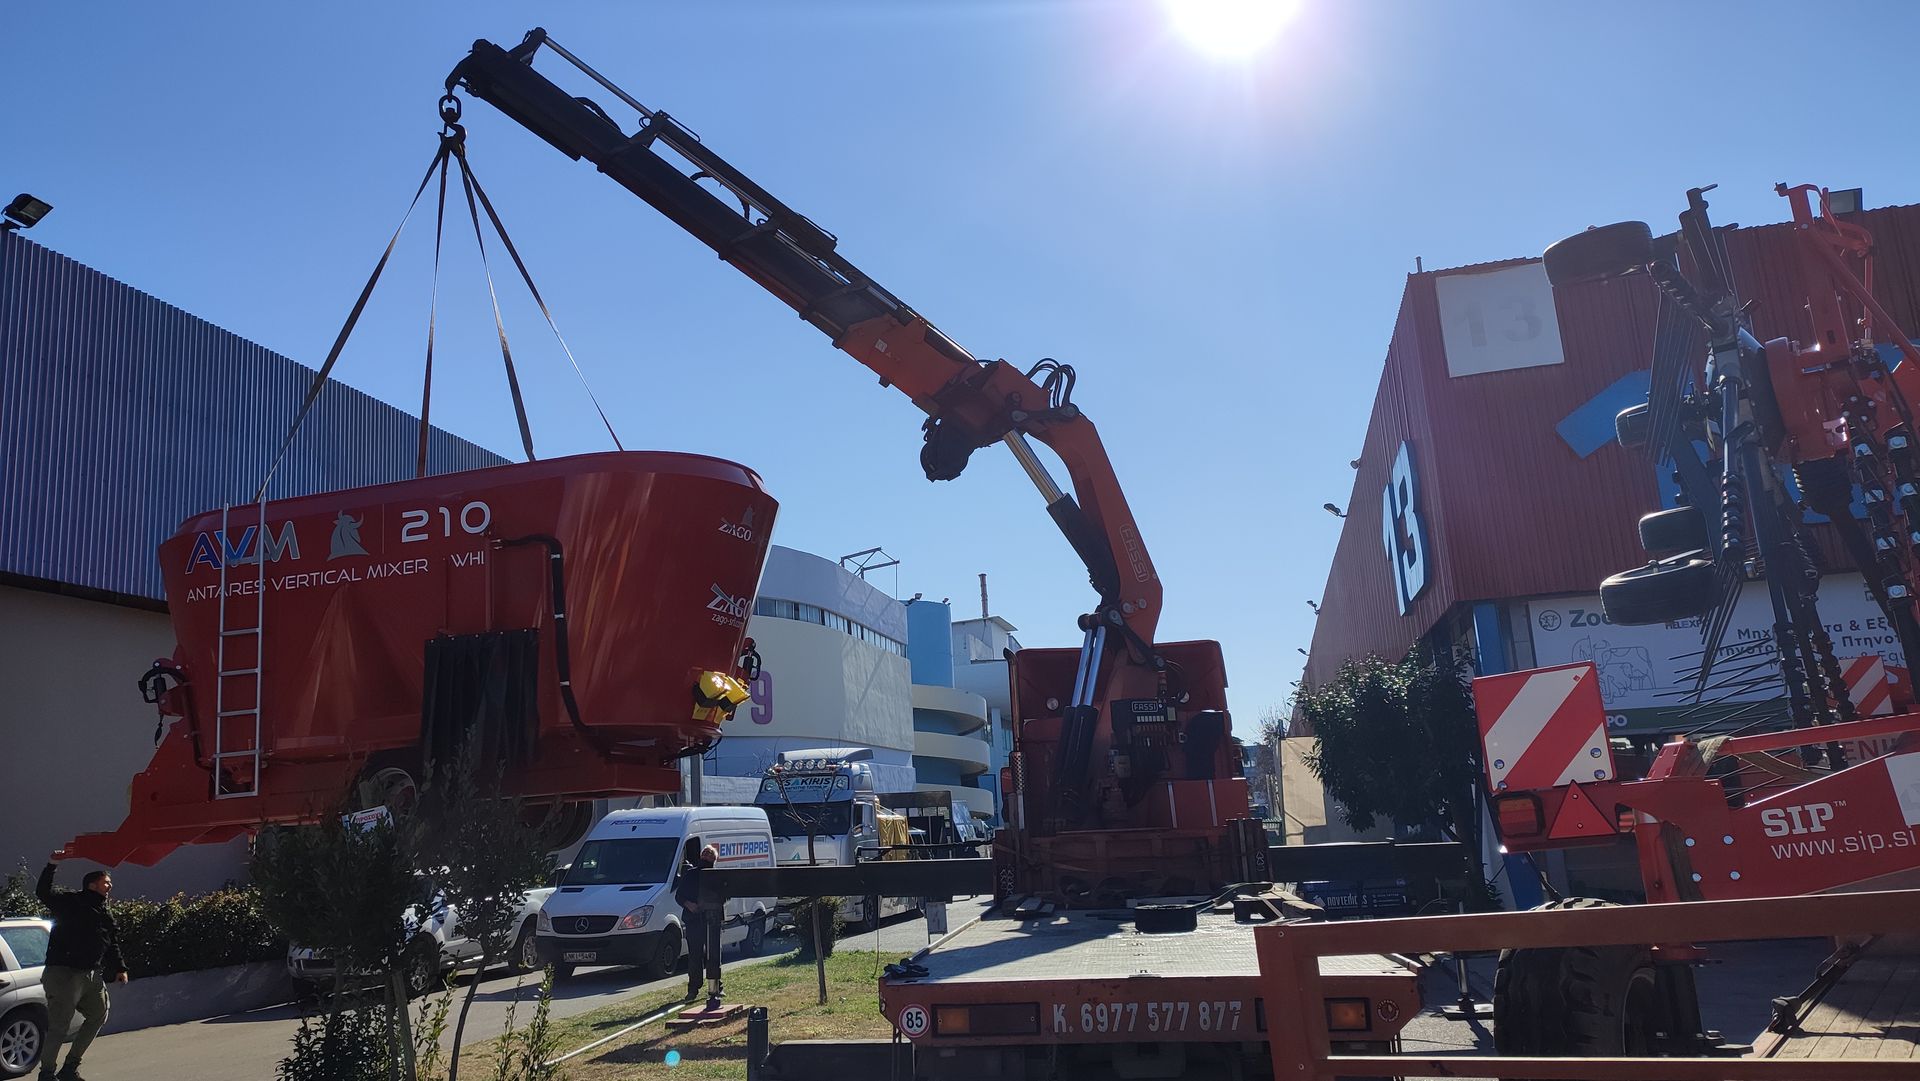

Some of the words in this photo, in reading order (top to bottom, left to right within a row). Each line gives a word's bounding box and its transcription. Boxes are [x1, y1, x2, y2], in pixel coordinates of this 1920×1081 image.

[184, 520, 301, 575] AVM
[401, 501, 491, 543] 210
[1382, 440, 1426, 617] 13
[186, 579, 266, 603] ANTARES
[271, 567, 361, 591] VERTICAL
[366, 558, 429, 580] MIXER
[1849, 619, 1861, 631] &
[750, 670, 773, 725] 9
[1133, 702, 1157, 712] FASSI
[1760, 802, 1834, 838] SIP
[1771, 826, 1917, 860] www.sip.si
[905, 1010, 924, 1029] 85
[1080, 1002, 1139, 1033] 6977
[1147, 1002, 1190, 1032] 577
[1199, 1001, 1242, 1031] 877
